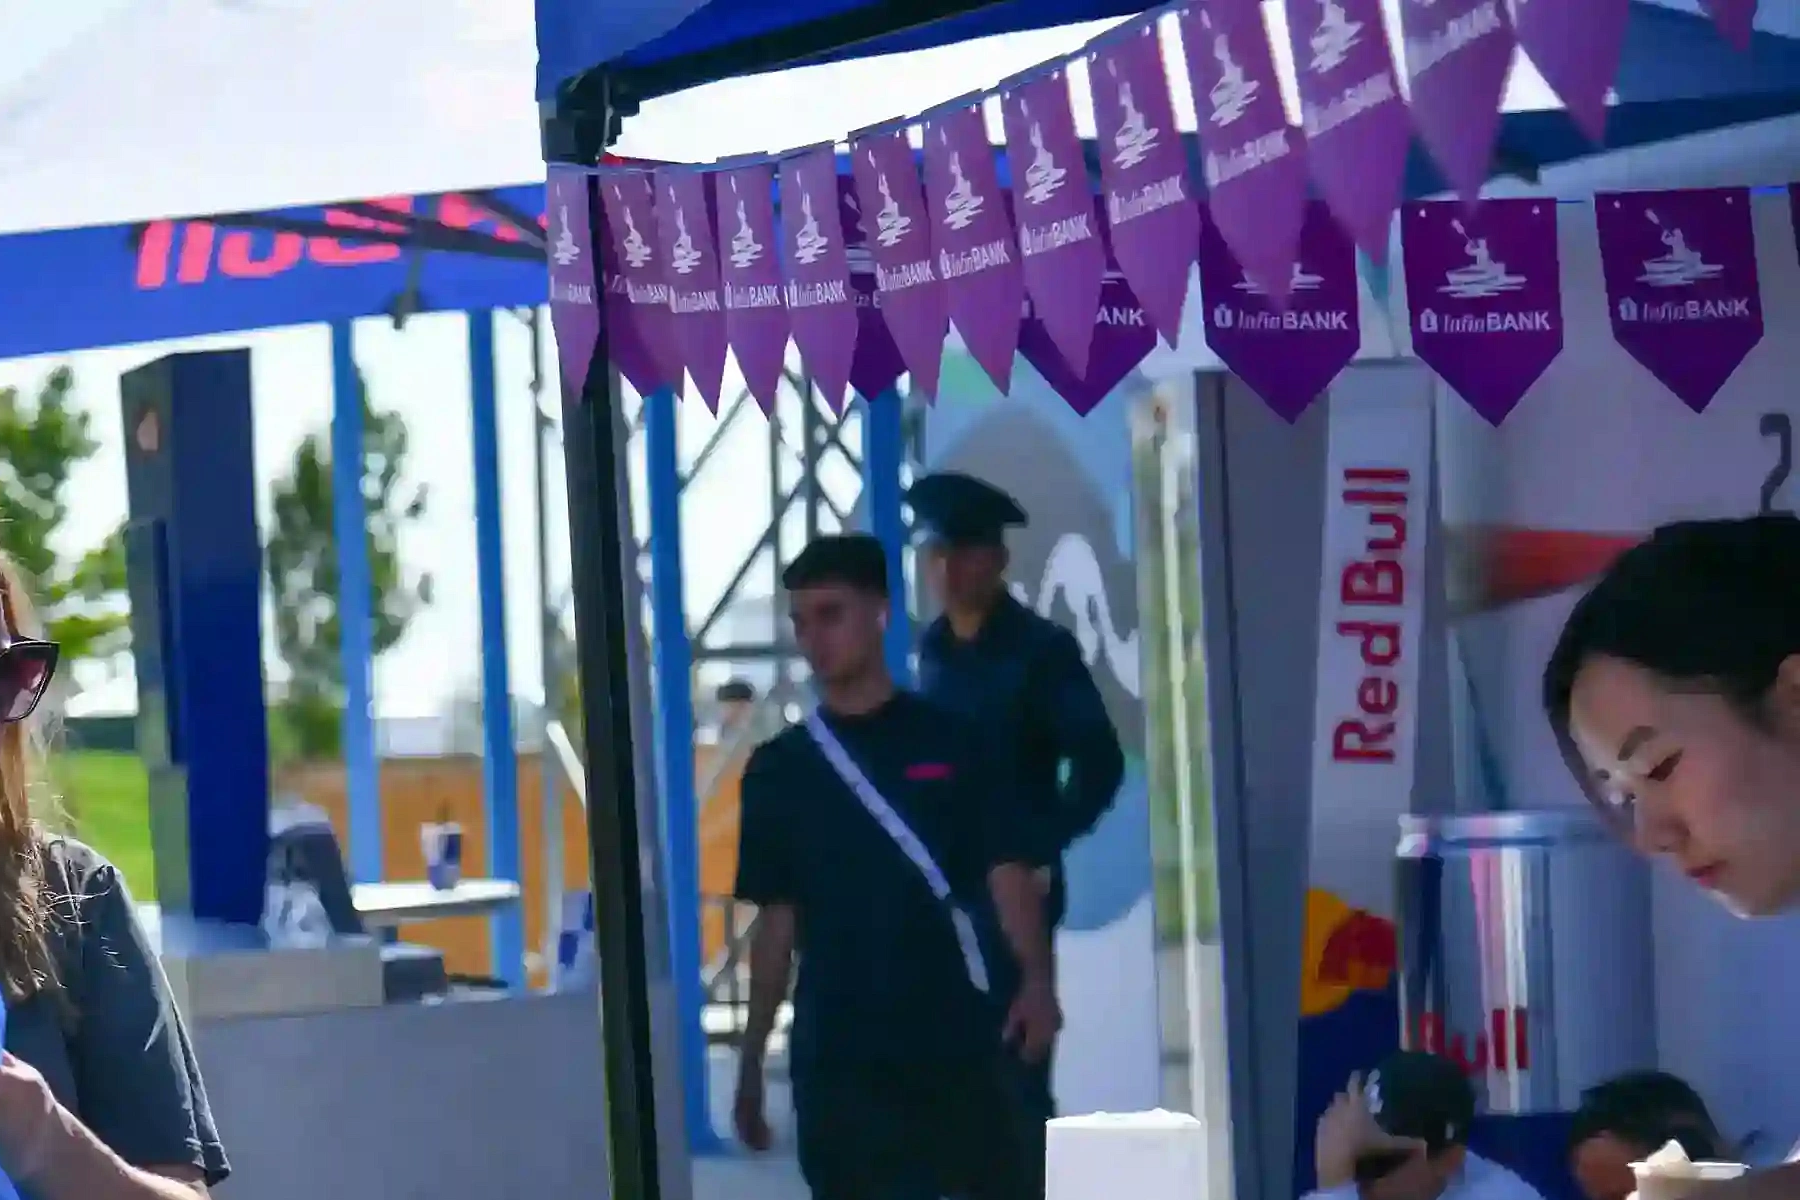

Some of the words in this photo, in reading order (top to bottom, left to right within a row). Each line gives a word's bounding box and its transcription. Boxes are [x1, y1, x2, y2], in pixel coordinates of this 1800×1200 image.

[1239, 310, 1349, 330] InfinBANK
[1643, 297, 1751, 322] InfinBANK
[1443, 312, 1551, 333] InfinBANK
[1342, 469, 1411, 604] Bull
[1333, 622, 1401, 763] Red
